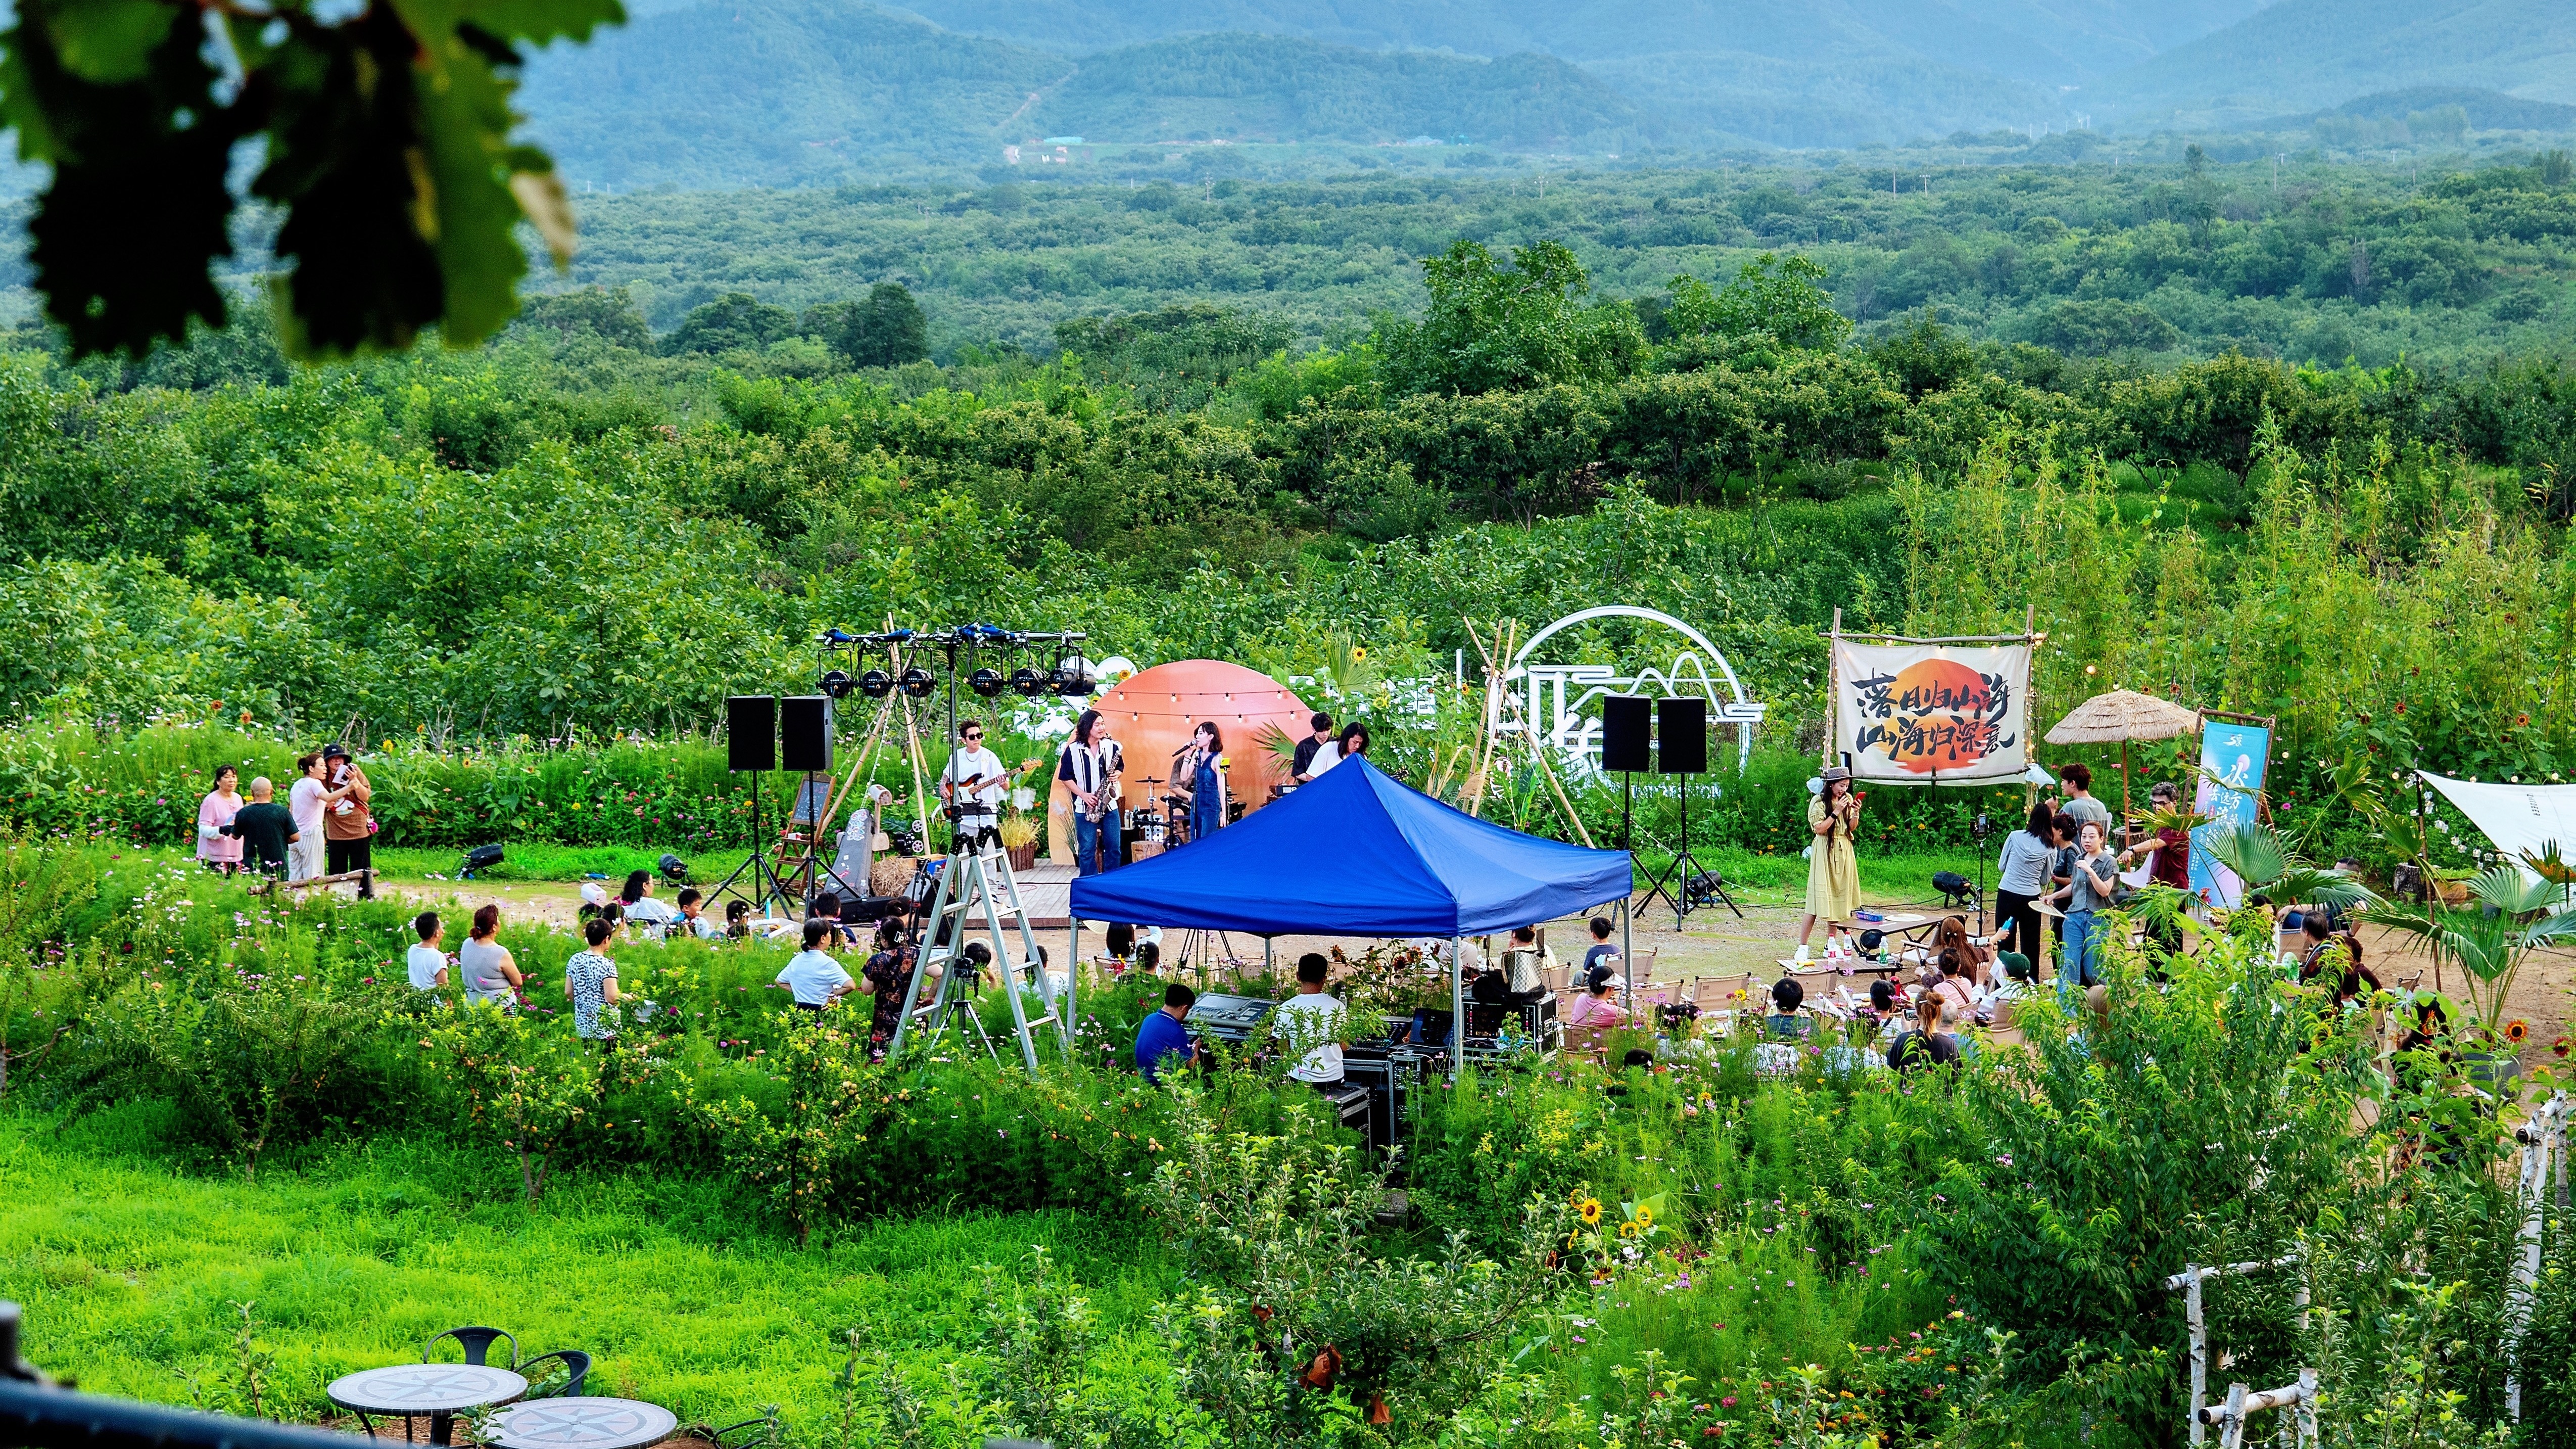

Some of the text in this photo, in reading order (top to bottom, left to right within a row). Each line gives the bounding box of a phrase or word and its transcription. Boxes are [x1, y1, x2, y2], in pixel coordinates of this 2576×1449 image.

[1851, 667, 2018, 724] 落日归山海
[1856, 714, 2015, 761] 山海归深意
